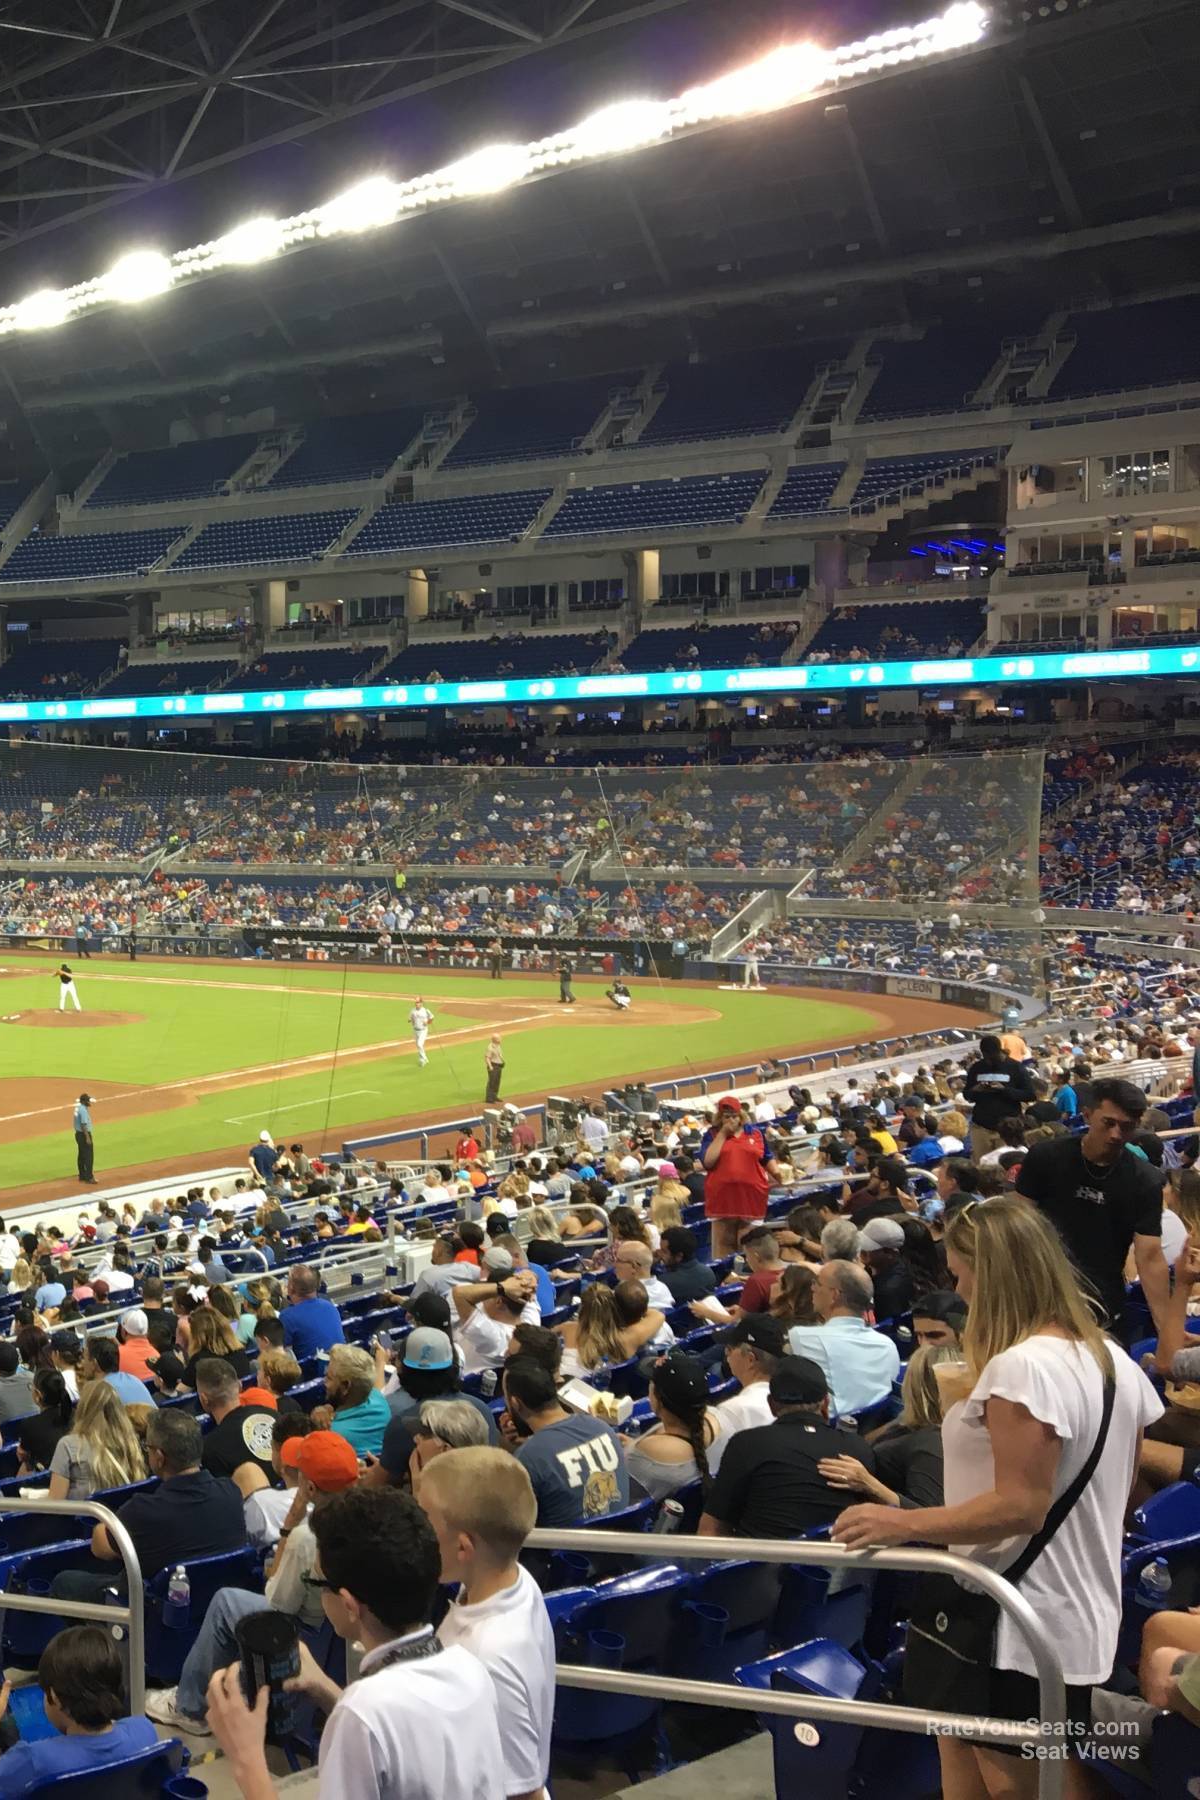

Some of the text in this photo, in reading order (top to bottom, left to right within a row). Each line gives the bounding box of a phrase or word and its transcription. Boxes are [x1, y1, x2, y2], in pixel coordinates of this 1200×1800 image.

[907, 982, 932, 993] LEON
[556, 1433, 619, 1488] FIU
[800, 1727, 814, 1741] 10
